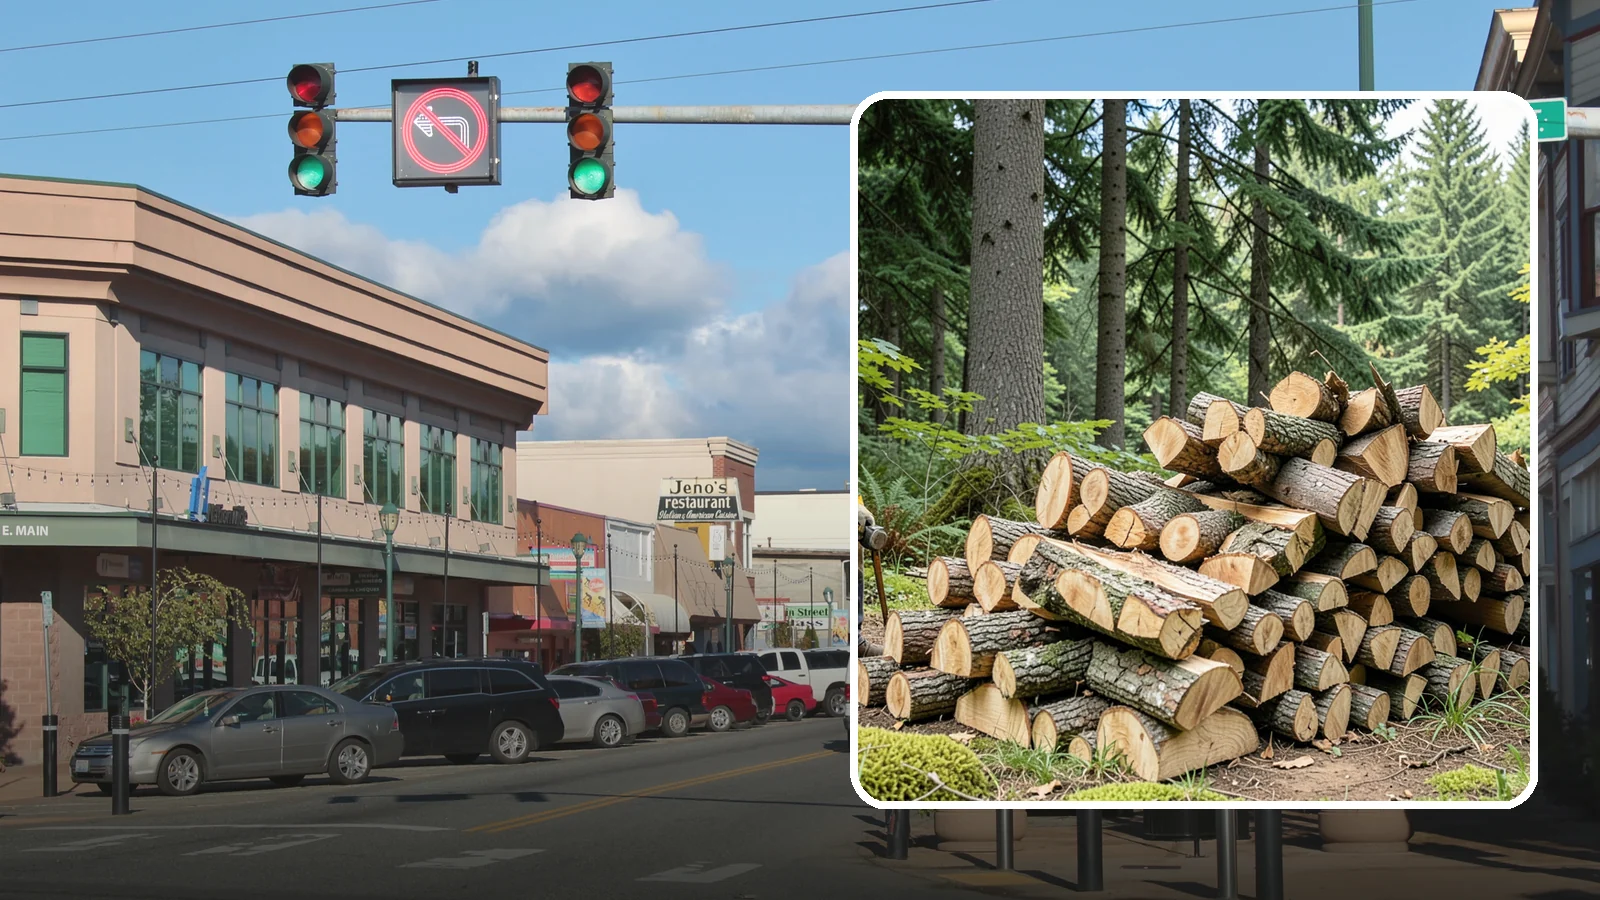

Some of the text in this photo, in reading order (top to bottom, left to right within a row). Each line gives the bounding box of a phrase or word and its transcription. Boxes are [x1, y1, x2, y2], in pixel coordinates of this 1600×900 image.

[670, 480, 727, 494] Jeno's
[665, 497, 731, 509] restaurant
[658, 510, 682, 519] Italian
[686, 509, 715, 519] American
[716, 509, 738, 519] Cuisine
[2, 525, 49, 536] E. MAIN
[797, 607, 828, 617] Street
